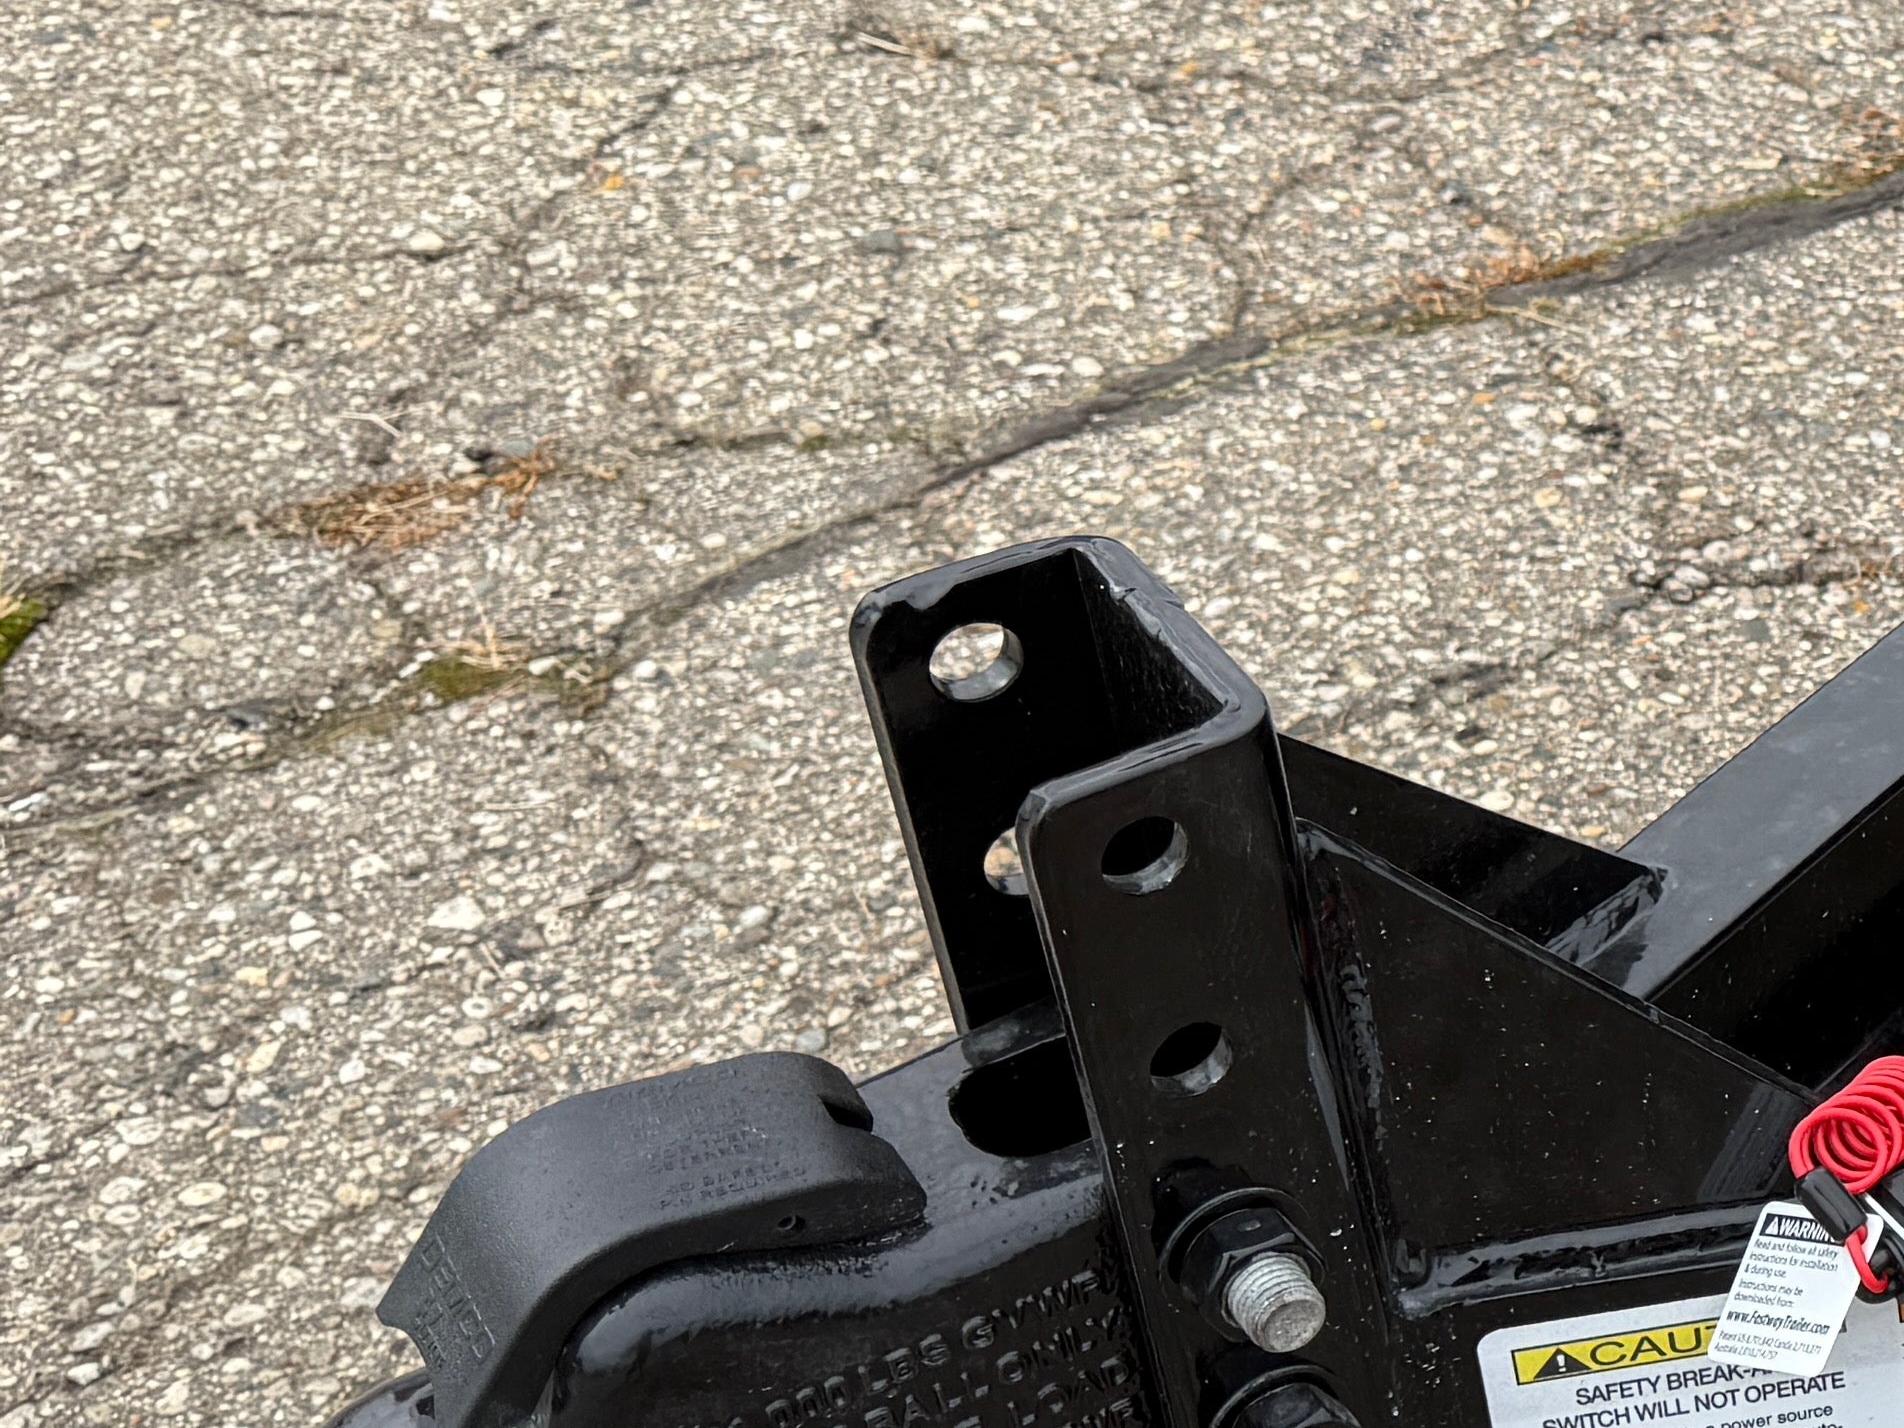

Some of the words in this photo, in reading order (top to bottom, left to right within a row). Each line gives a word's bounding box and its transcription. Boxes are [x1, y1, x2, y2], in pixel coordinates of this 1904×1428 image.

[1575, 1375, 1661, 1405] SAFETY
[1635, 1397, 1690, 1422] WILL
[1695, 1389, 1738, 1412] NOT
[1744, 1371, 1845, 1404] OPERATE
[1777, 1405, 1834, 1424] source
